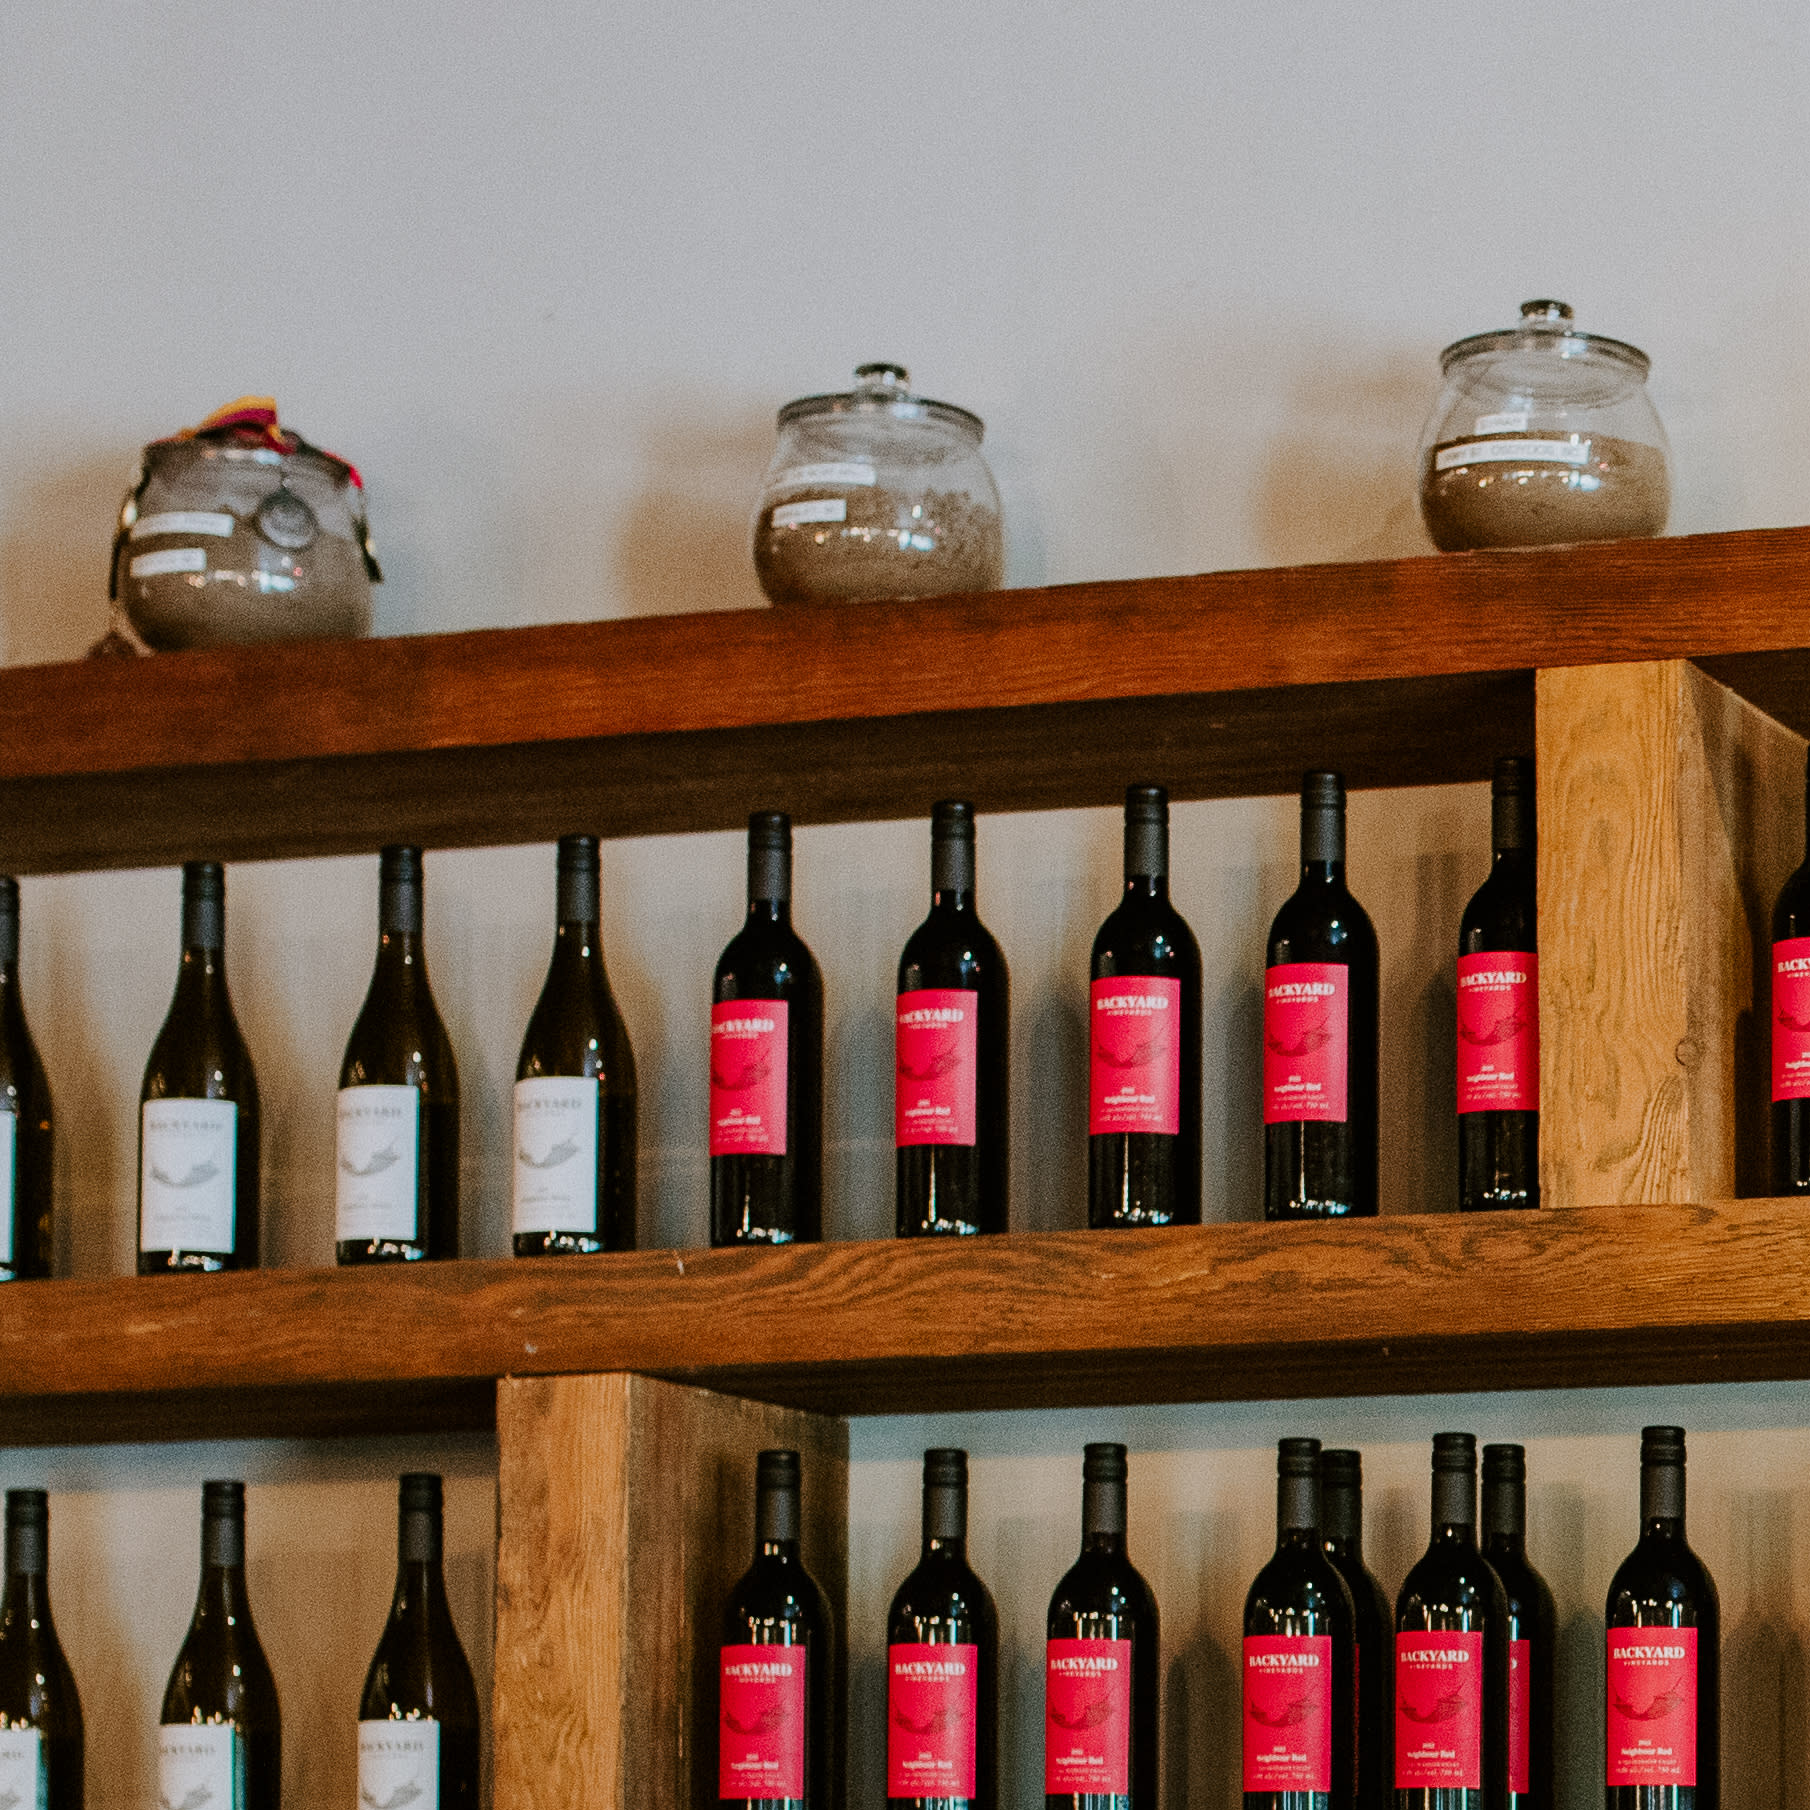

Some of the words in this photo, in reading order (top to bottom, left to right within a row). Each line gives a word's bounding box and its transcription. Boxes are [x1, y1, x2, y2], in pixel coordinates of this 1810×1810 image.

[1401, 1649, 1470, 1663] BACKYARD
[1613, 1646, 1686, 1660] BACKYARD
[1249, 1654, 1319, 1668] BACKYARD
